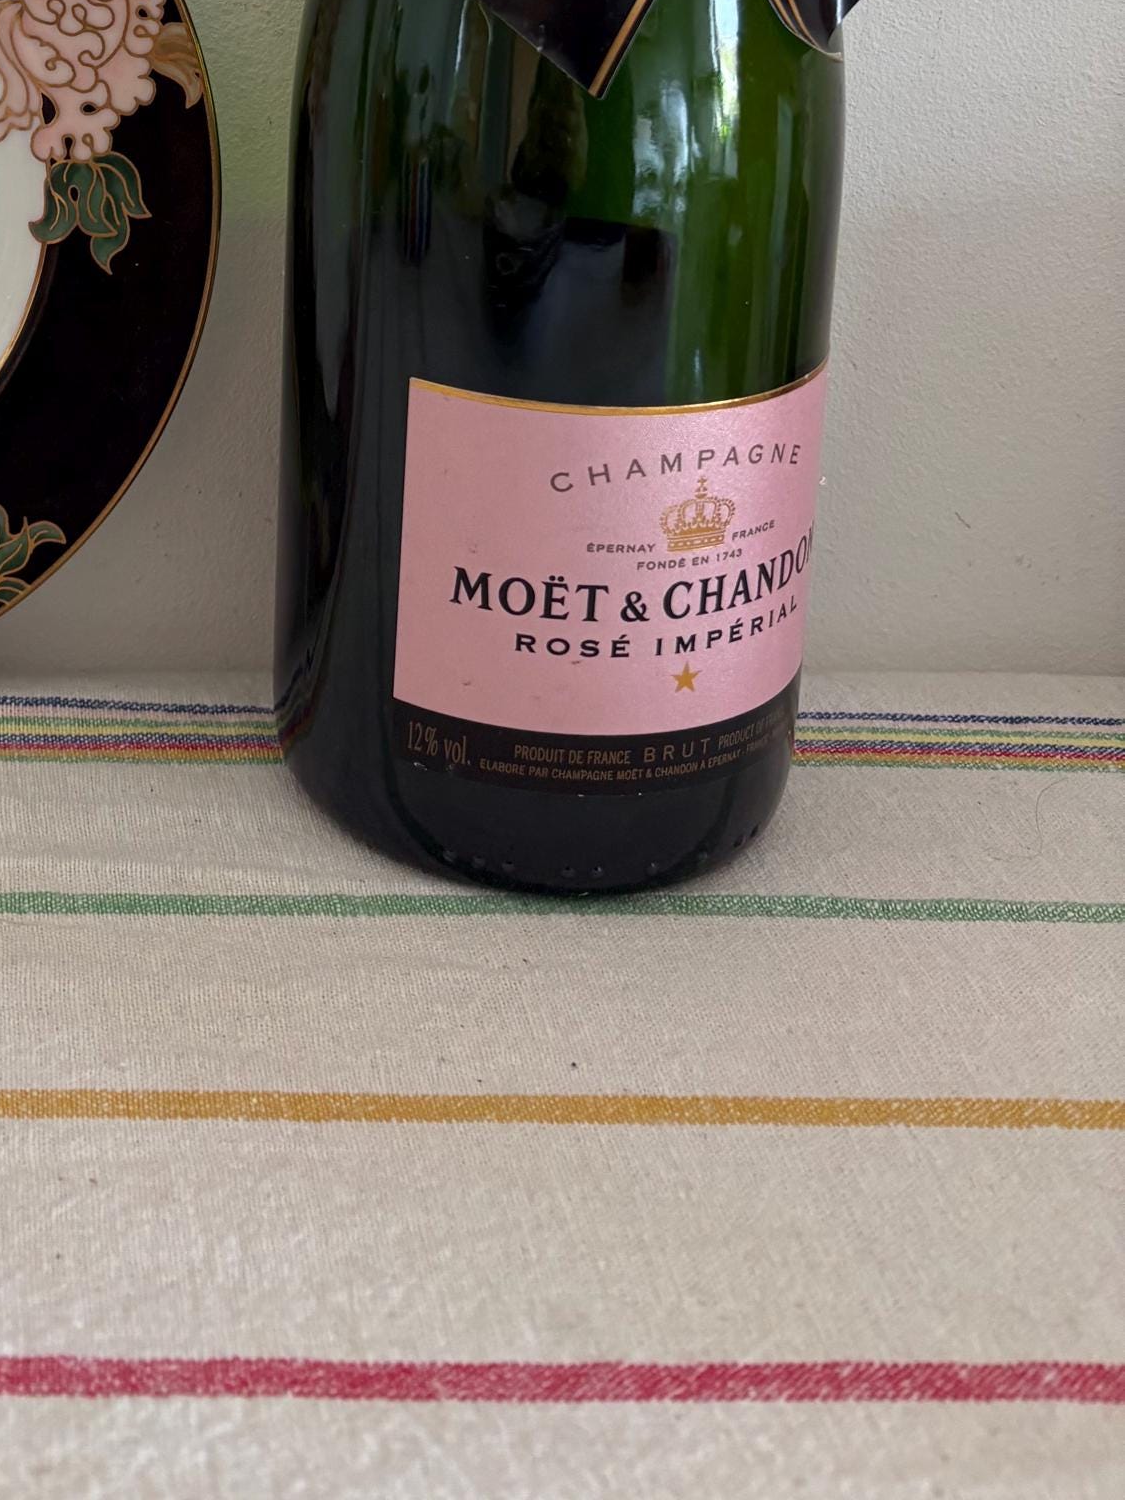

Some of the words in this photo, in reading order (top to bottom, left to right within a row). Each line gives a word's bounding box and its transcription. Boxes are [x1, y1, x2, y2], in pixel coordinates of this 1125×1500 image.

[549, 443, 801, 493] CHAMPAGNE
[586, 542, 656, 554] ÉPERNAY
[732, 519, 776, 541] FRANCE
[637, 557, 687, 571] FONDÉ
[692, 556, 710, 567] EN
[716, 548, 743, 563] 1743
[449, 566, 610, 622] MOËT
[620, 591, 651, 623] &
[515, 633, 631, 659] ROSÉ
[655, 595, 798, 657] IMPÉRIAL
[407, 721, 438, 757] 12%
[443, 736, 472, 766] vol.
[514, 744, 566, 764] PRODUIT
[568, 749, 584, 765] DE
[586, 750, 633, 766] FRANCE
[643, 738, 711, 764] BRUT
[528, 765, 549, 778] PAR
[552, 767, 614, 781] CHAMPAGNE
[645, 768, 653, 779] &
[655, 762, 699, 779] CHANDON
